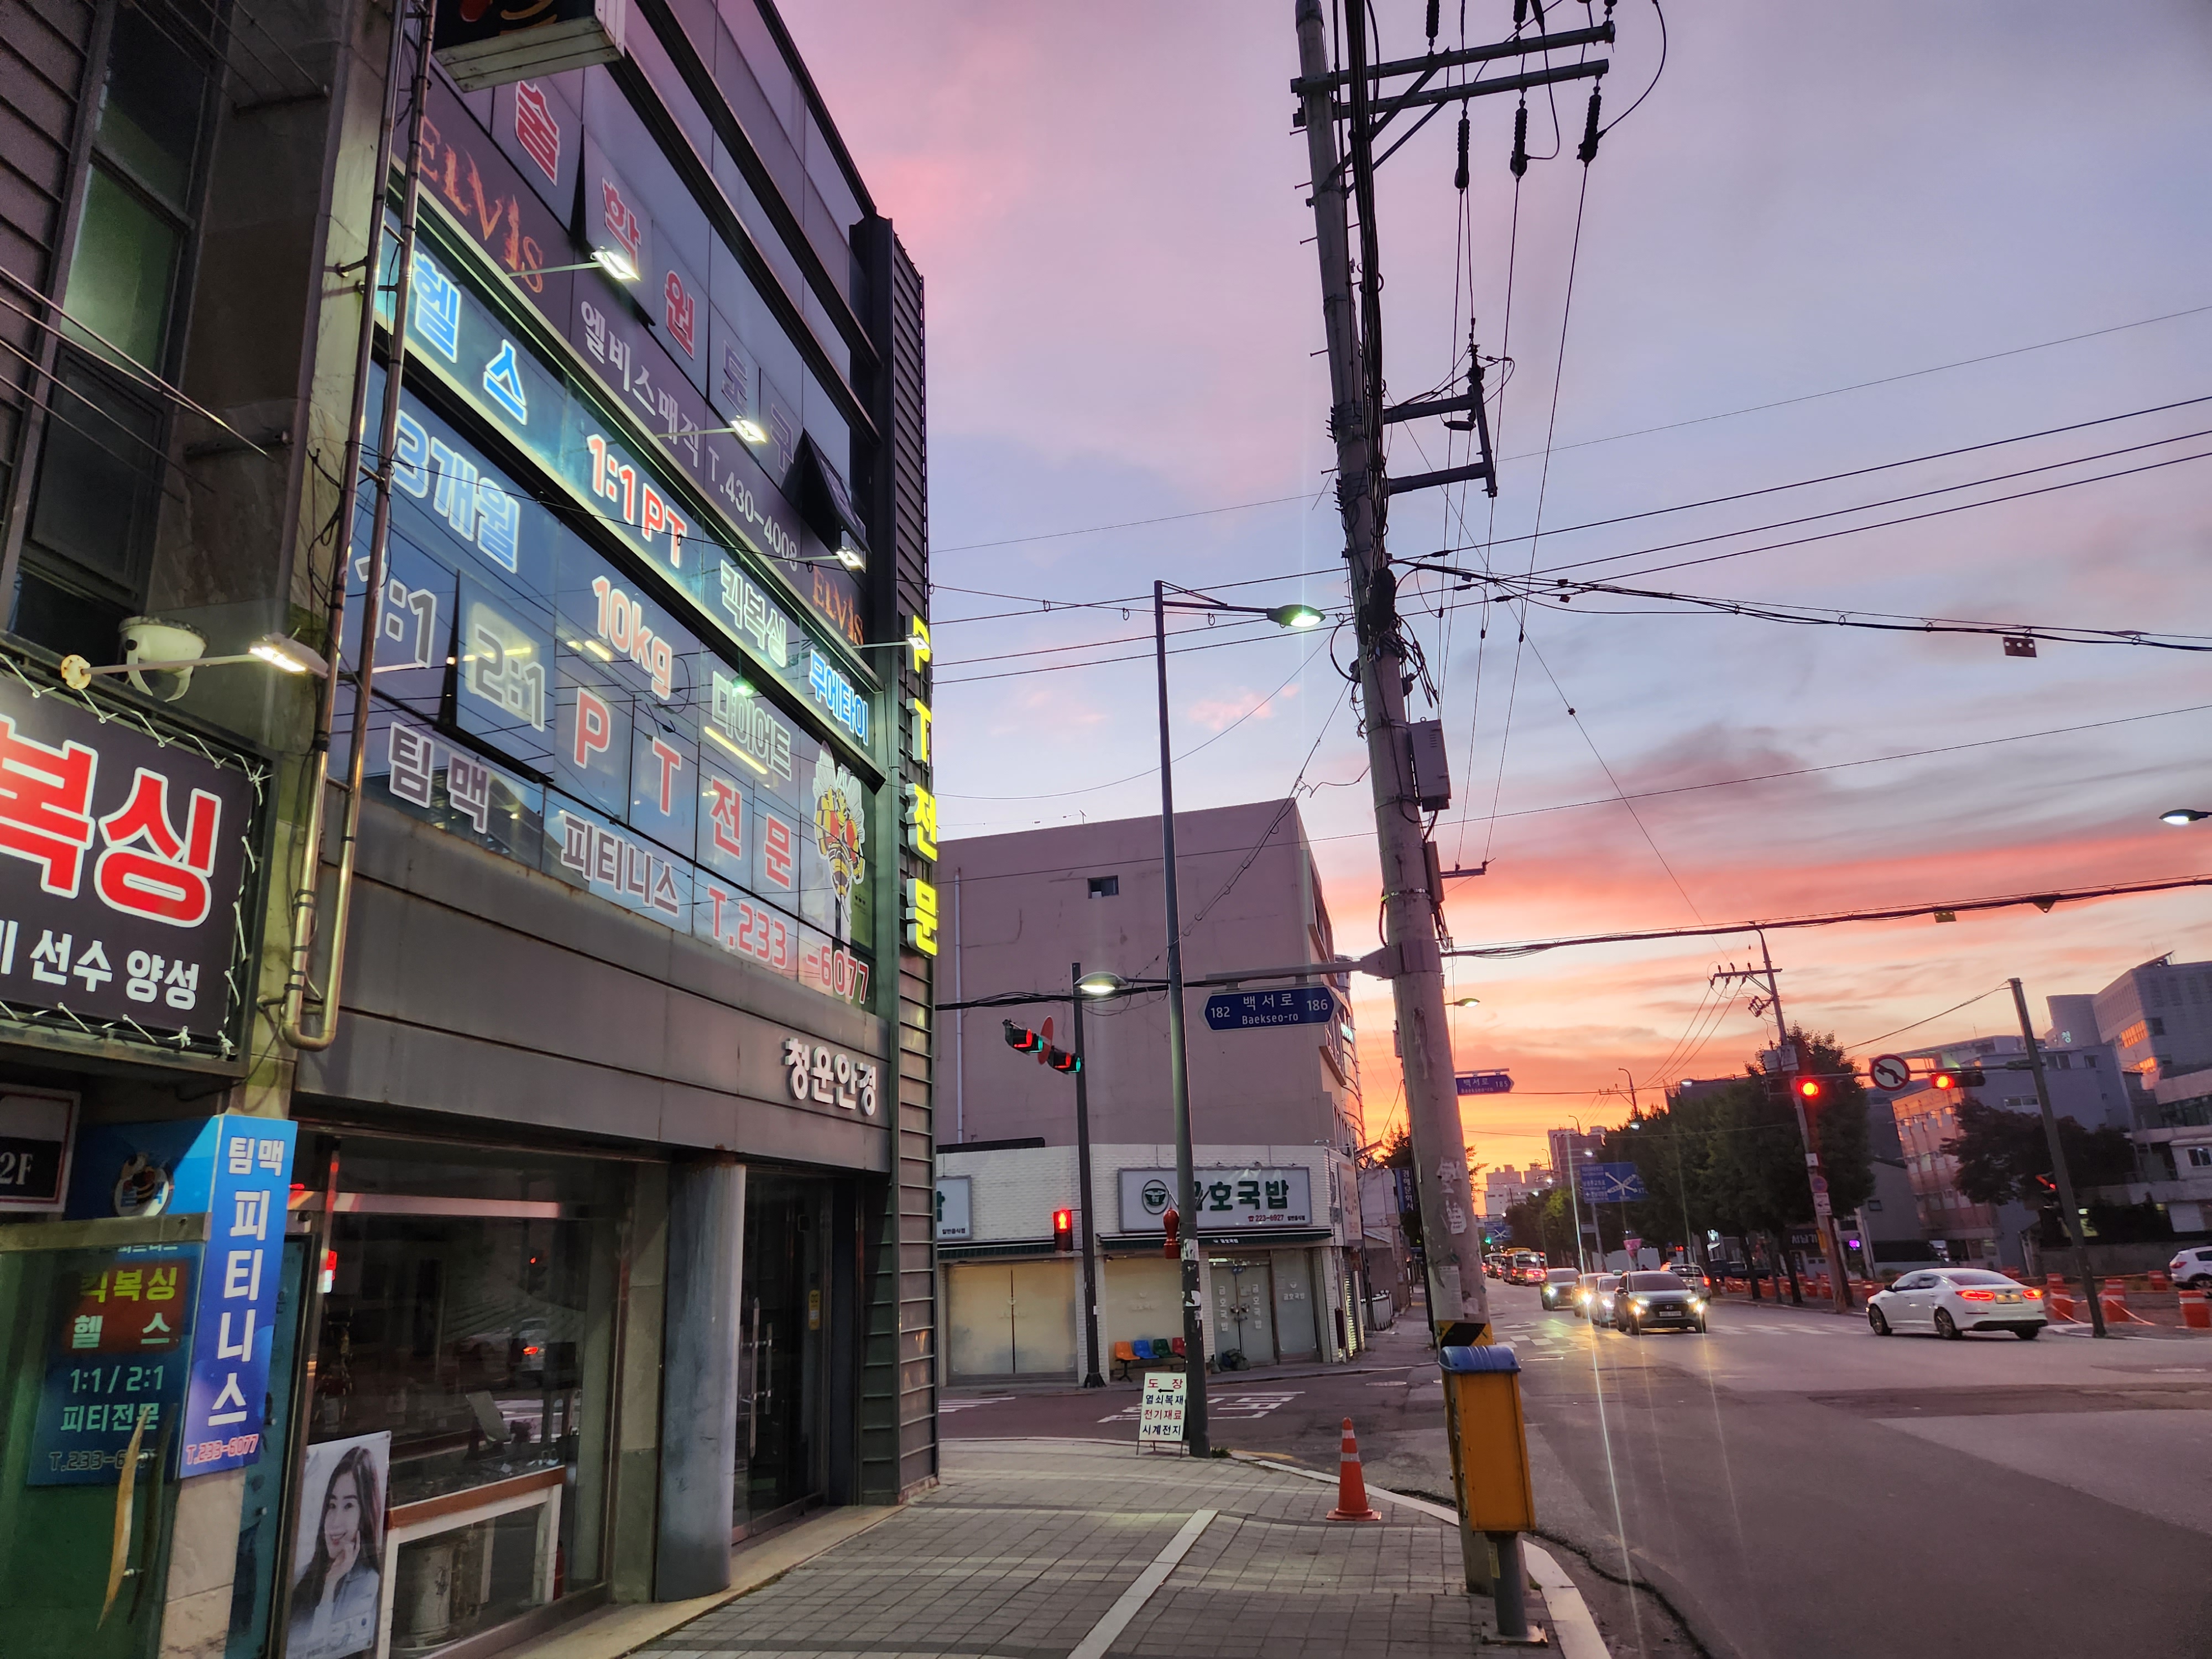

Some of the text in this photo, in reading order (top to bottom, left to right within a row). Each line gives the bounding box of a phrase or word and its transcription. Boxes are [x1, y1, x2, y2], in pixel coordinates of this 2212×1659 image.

[581, 301, 699, 468] 엘비스매직
[393, 408, 521, 574] 3개월
[587, 434, 635, 525] 1:1
[642, 482, 687, 569] PT
[720, 559, 787, 668] 킥복싱
[809, 648, 869, 747] 무에타이
[812, 565, 864, 646] ELVIS
[474, 623, 545, 733] 2:1
[592, 575, 792, 781] 10kg 다이어트
[0, 713, 221, 928] 복싱
[561, 811, 680, 919] 피티니스
[30, 929, 112, 992] 선수
[126, 950, 200, 1010] 양성
[1243, 993, 1294, 1011] 백서로
[1306, 999, 1328, 1011] 186
[1211, 1006, 1230, 1019] 182
[1241, 1013, 1298, 1025] Baekseo-ro
[784, 1037, 877, 1116] 청운안경
[228, 1136, 285, 1176] 팀맥
[208, 1190, 270, 1427] 피티니스
[60, 1402, 159, 1432] 피티전문
[1144, 1409, 1182, 1421] 전기재료
[1147, 1379, 1183, 1389] 도장
[185, 1433, 259, 1465] T.233-6077
[1142, 1424, 1181, 1436] 시계전지
